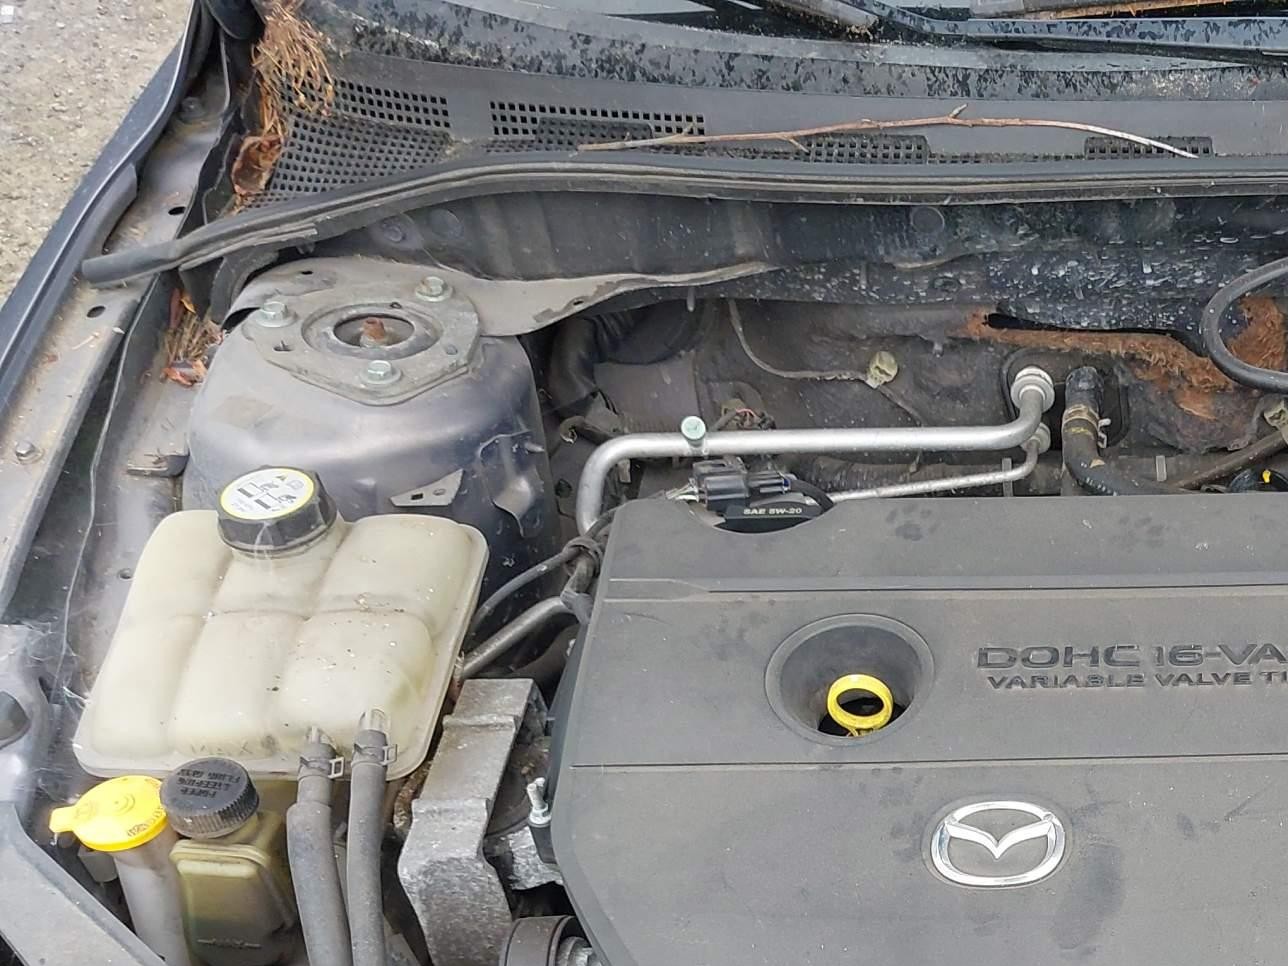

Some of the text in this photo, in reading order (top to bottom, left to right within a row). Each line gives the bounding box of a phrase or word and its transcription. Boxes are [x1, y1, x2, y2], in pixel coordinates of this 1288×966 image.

[743, 507, 803, 515] SAE 5W-20
[976, 645, 1141, 669] DOHC
[987, 674, 1146, 689] VARIABLE
[1154, 671, 1253, 687] VALVE
